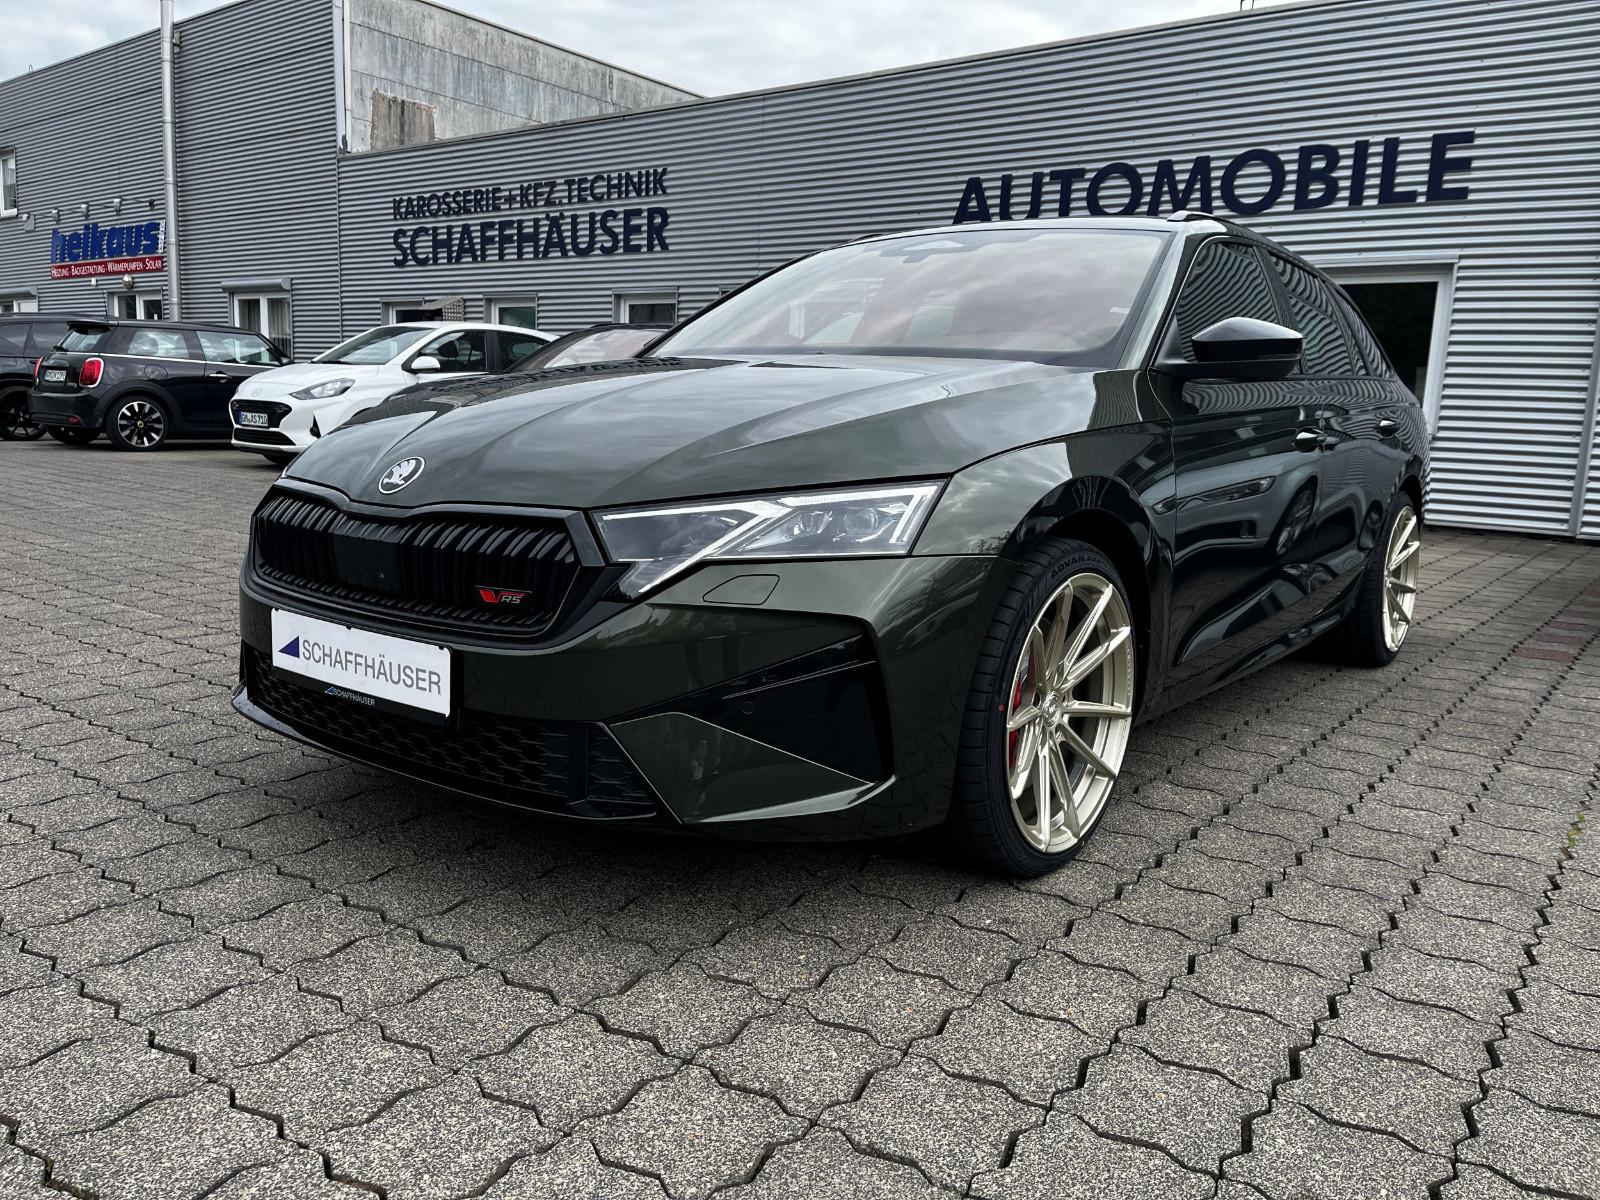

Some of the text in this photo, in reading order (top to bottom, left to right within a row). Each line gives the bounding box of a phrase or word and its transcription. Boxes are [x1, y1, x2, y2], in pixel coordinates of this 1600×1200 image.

[952, 130, 1475, 225] AUTOMOBILE
[51, 221, 161, 263] heikaus
[145, 258, 162, 270] SOLAR
[392, 206, 670, 268] SCHAFFHÄUSER
[302, 639, 442, 696] SCHAFFHÄUSER
